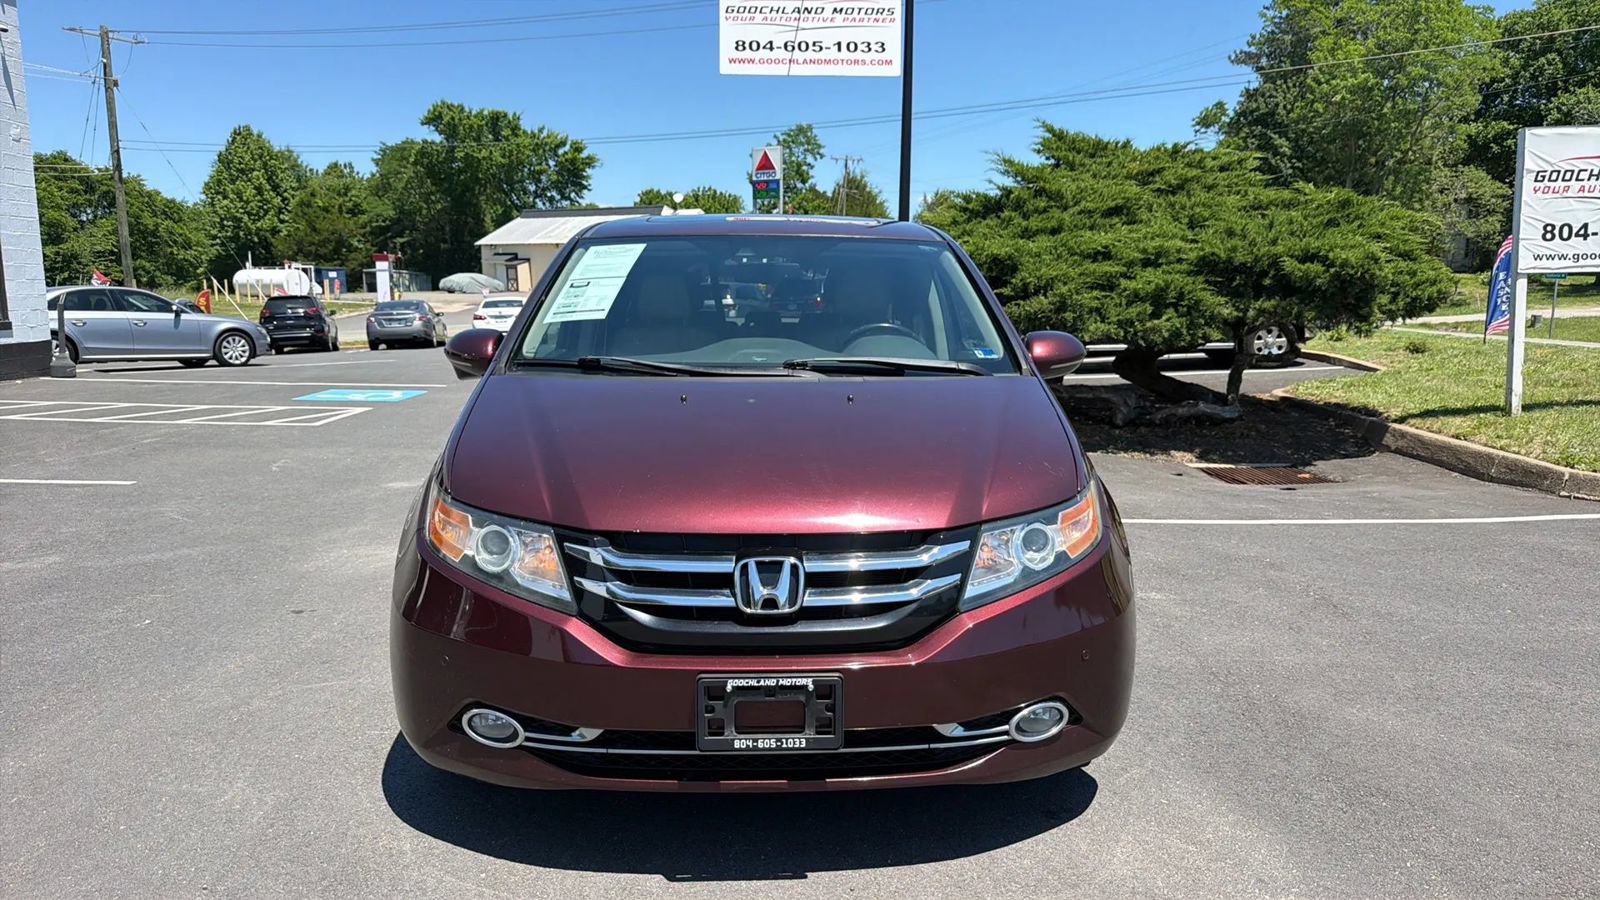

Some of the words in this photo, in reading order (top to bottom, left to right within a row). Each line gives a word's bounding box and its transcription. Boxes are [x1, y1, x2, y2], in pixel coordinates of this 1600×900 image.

[725, 5, 825, 15] GOOCHLAND
[831, 7, 896, 16] MOTORS
[761, 16, 837, 24] AUTOMOTIVE
[842, 16, 896, 24] PARTNER
[734, 40, 887, 54] 804-605-1033
[728, 57, 894, 66] WWW.GOOCHLANDMOTORS.COM
[1533, 185, 1571, 194] YOUR
[1576, 184, 1600, 194] AU
[1541, 222, 1599, 242] 804-
[1532, 252, 1600, 264] www.goo
[727, 679, 777, 687] GOOCHLAND
[778, 678, 813, 686] MOTORS
[734, 739, 806, 748] 804-605-1033
